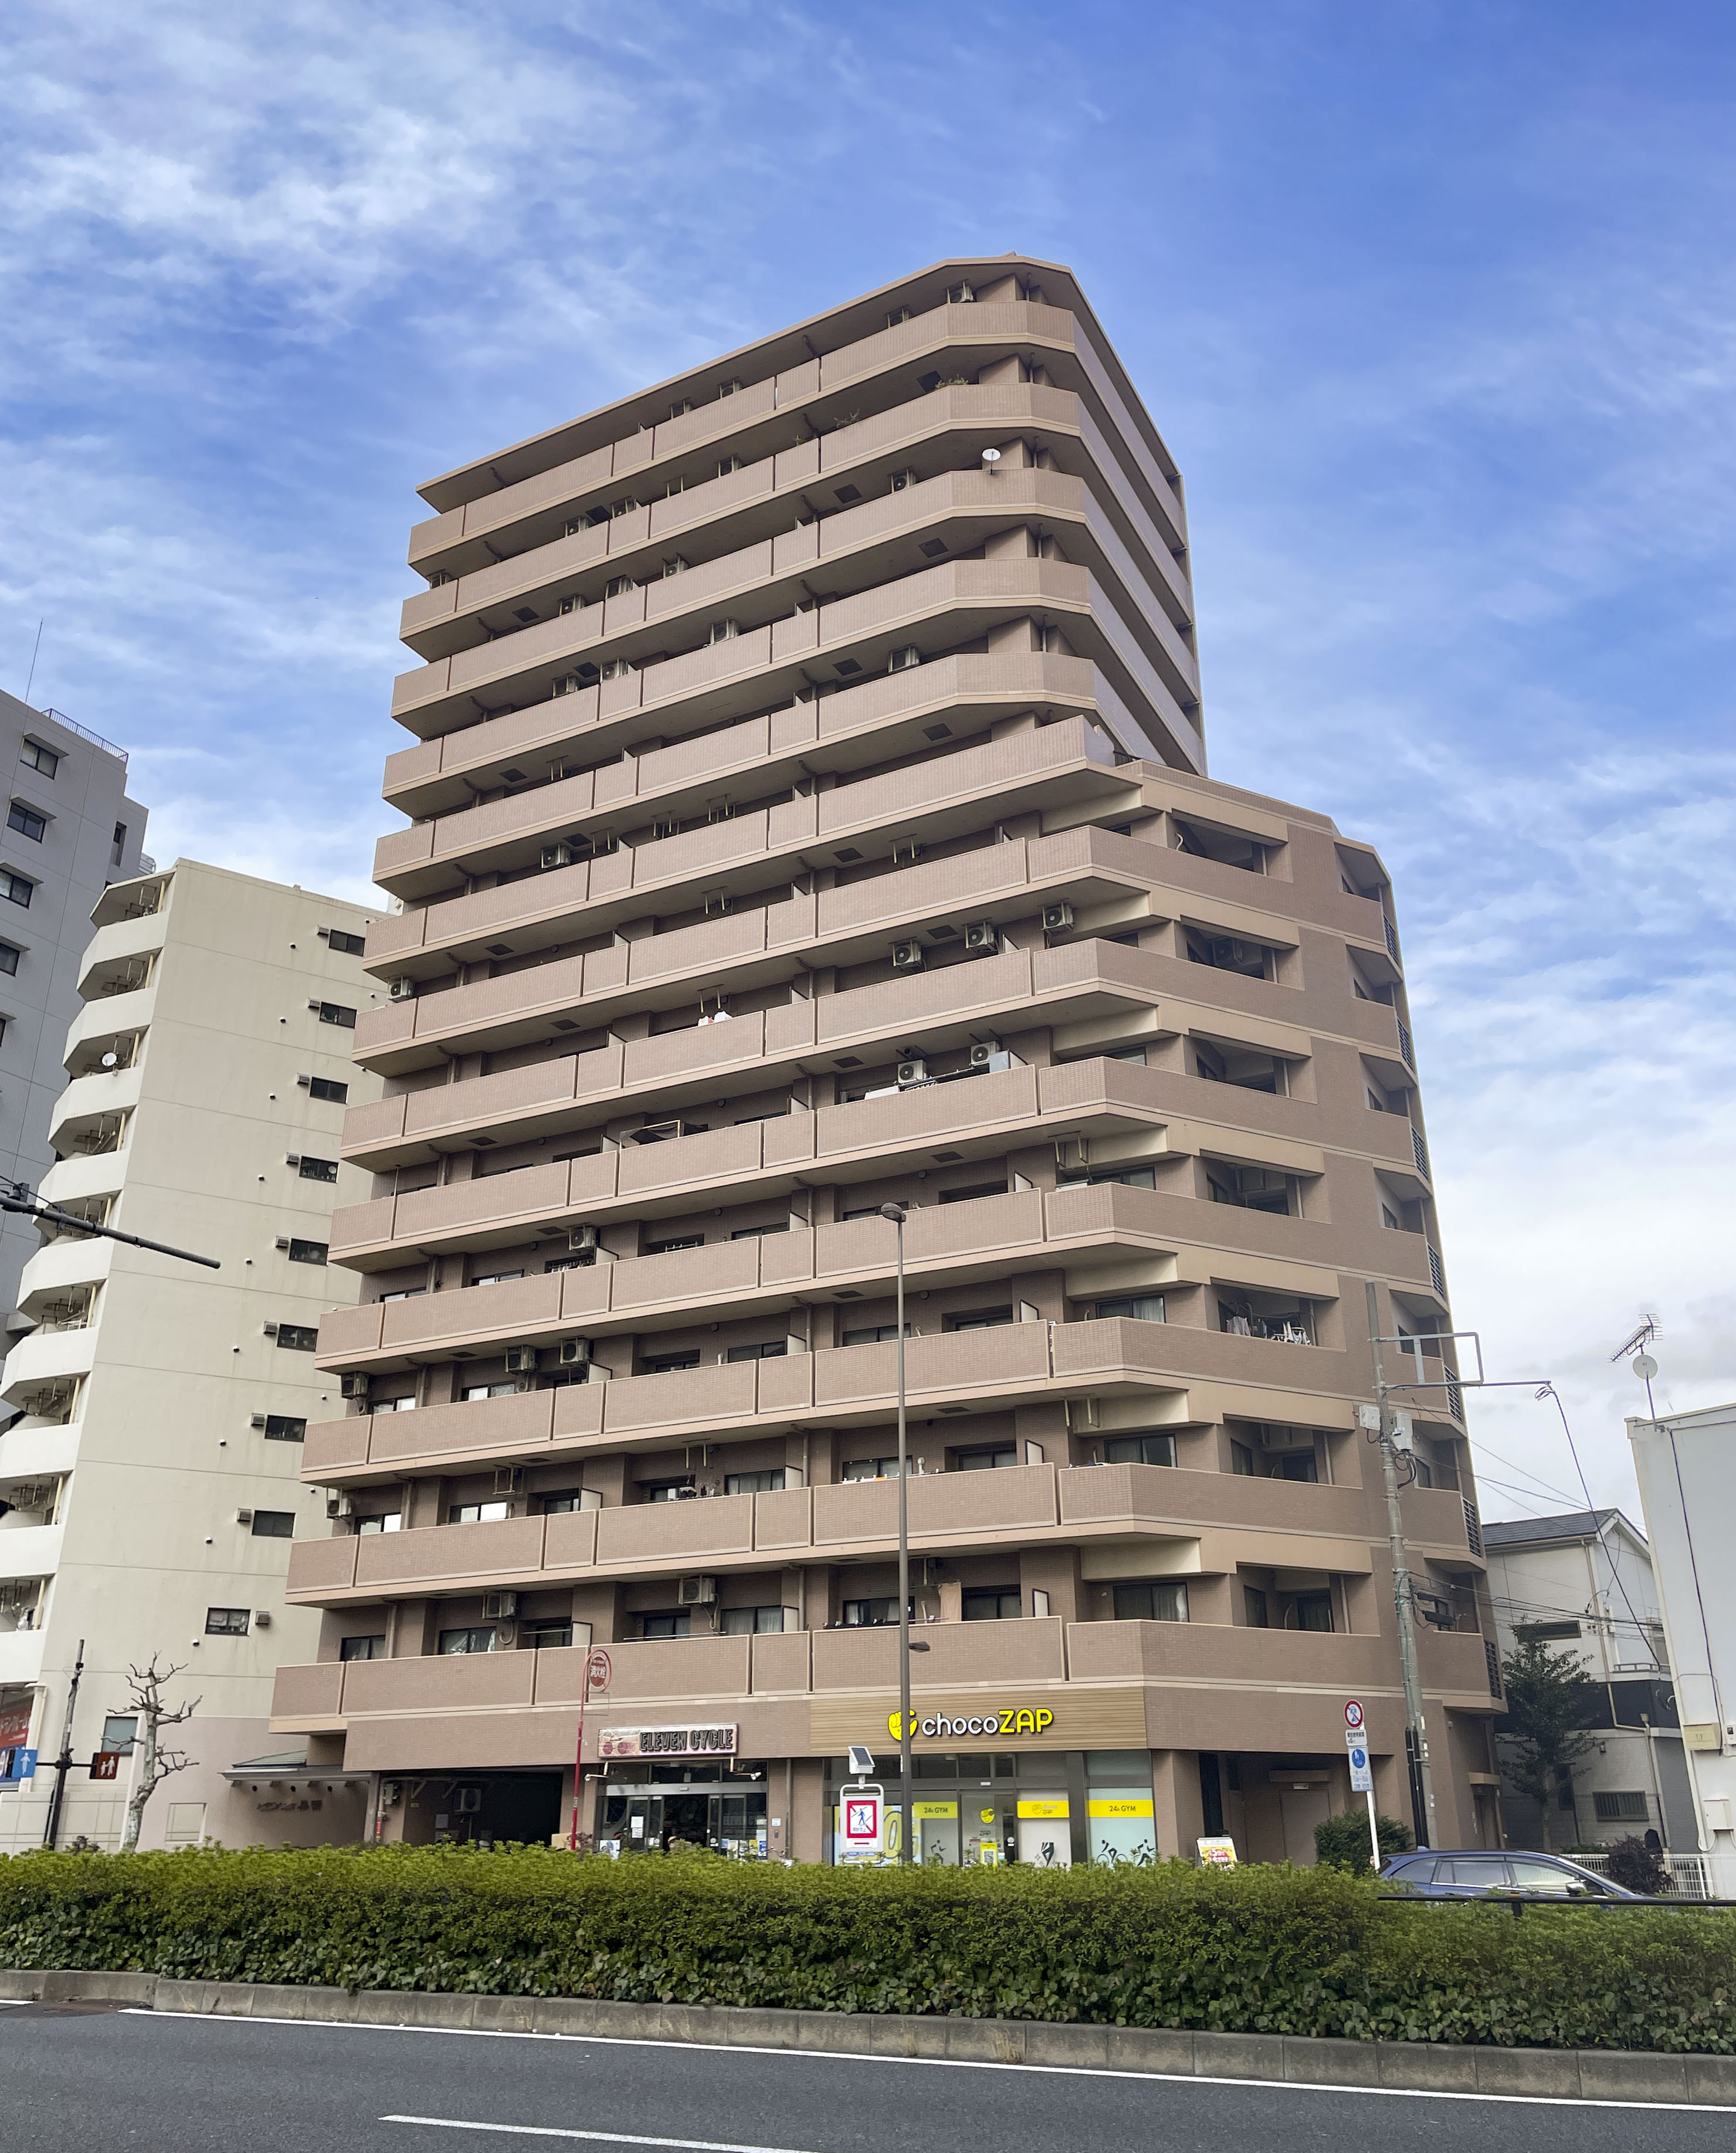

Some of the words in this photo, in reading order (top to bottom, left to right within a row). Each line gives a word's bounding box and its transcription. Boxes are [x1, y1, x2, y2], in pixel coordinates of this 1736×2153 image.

[590, 1665, 606, 1679] 消火栓
[921, 1708, 1054, 1737] chocoZAP
[639, 1731, 687, 1752] ELEVEN
[689, 1729, 733, 1750] CYCLE
